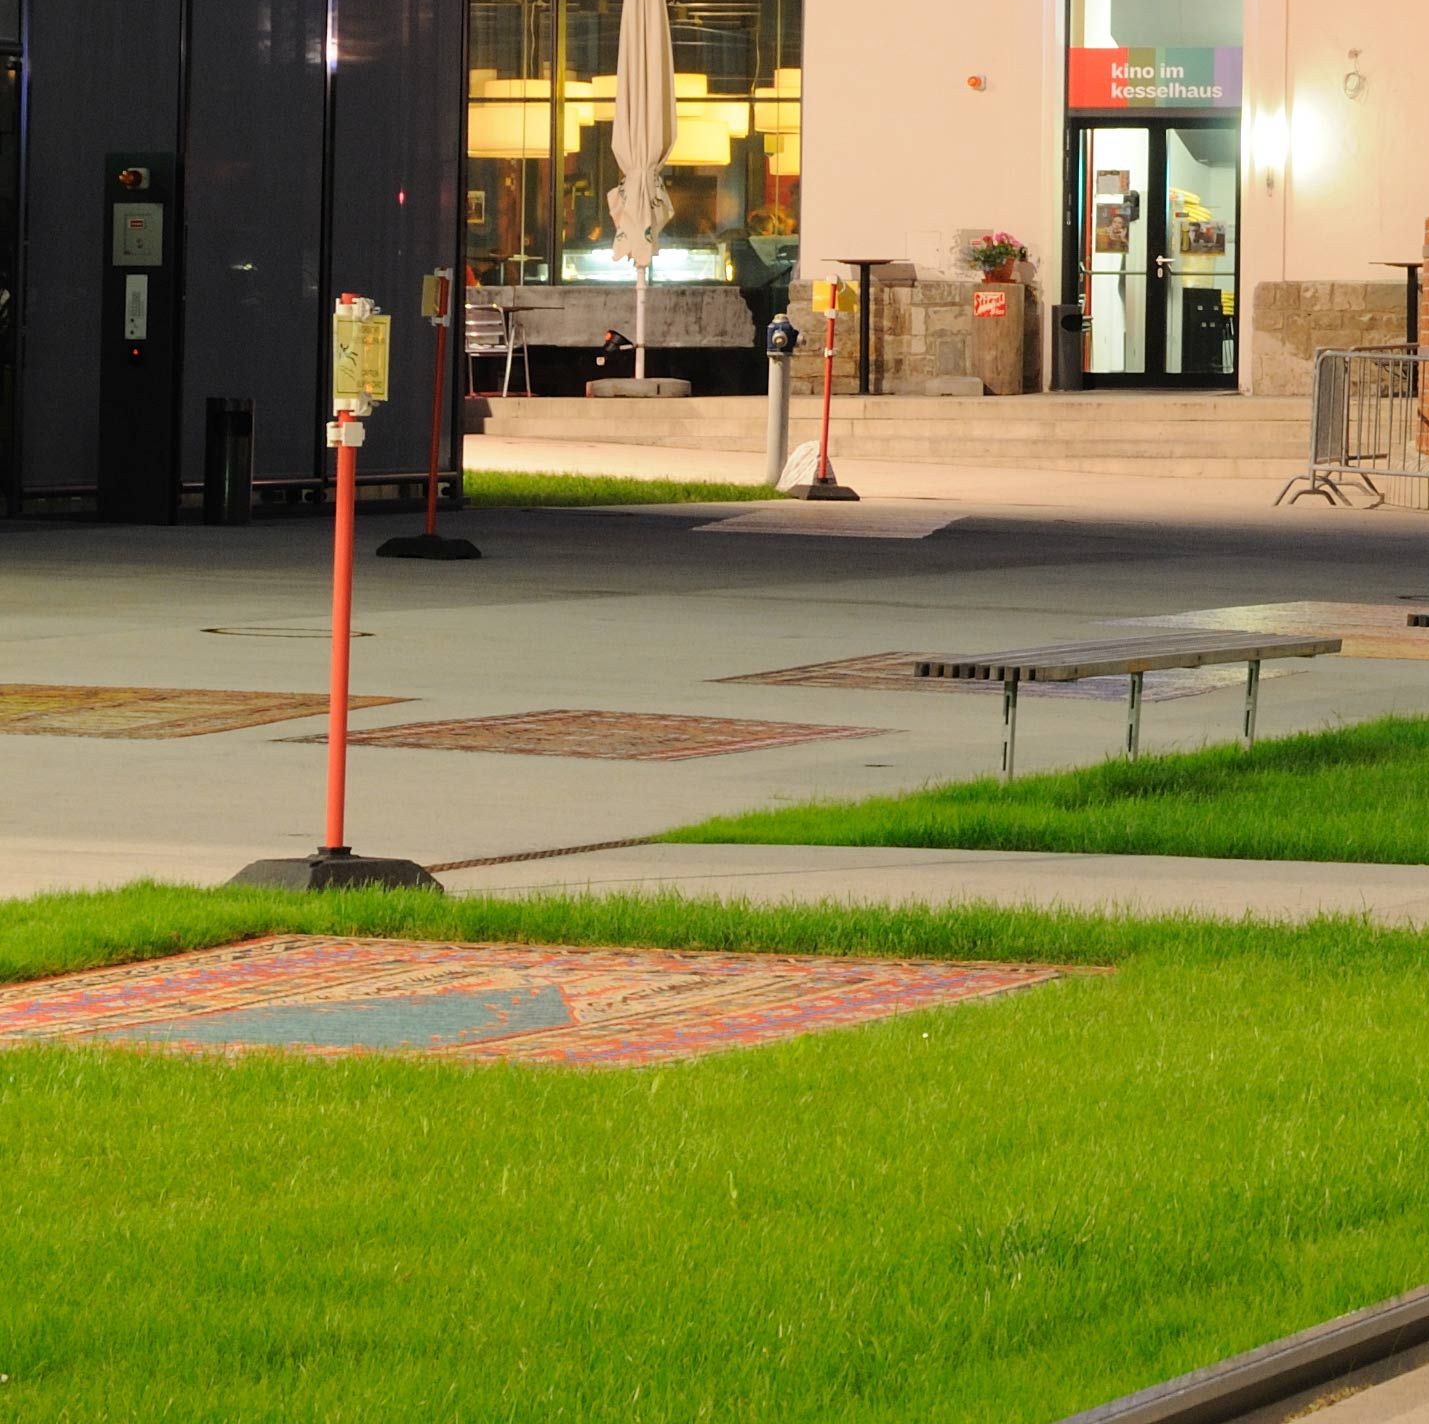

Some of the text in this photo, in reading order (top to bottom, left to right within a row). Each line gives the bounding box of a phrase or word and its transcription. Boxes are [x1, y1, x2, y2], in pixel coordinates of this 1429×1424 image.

[1111, 62, 1185, 79] kino im
[1111, 82, 1223, 99] kesselhaus
